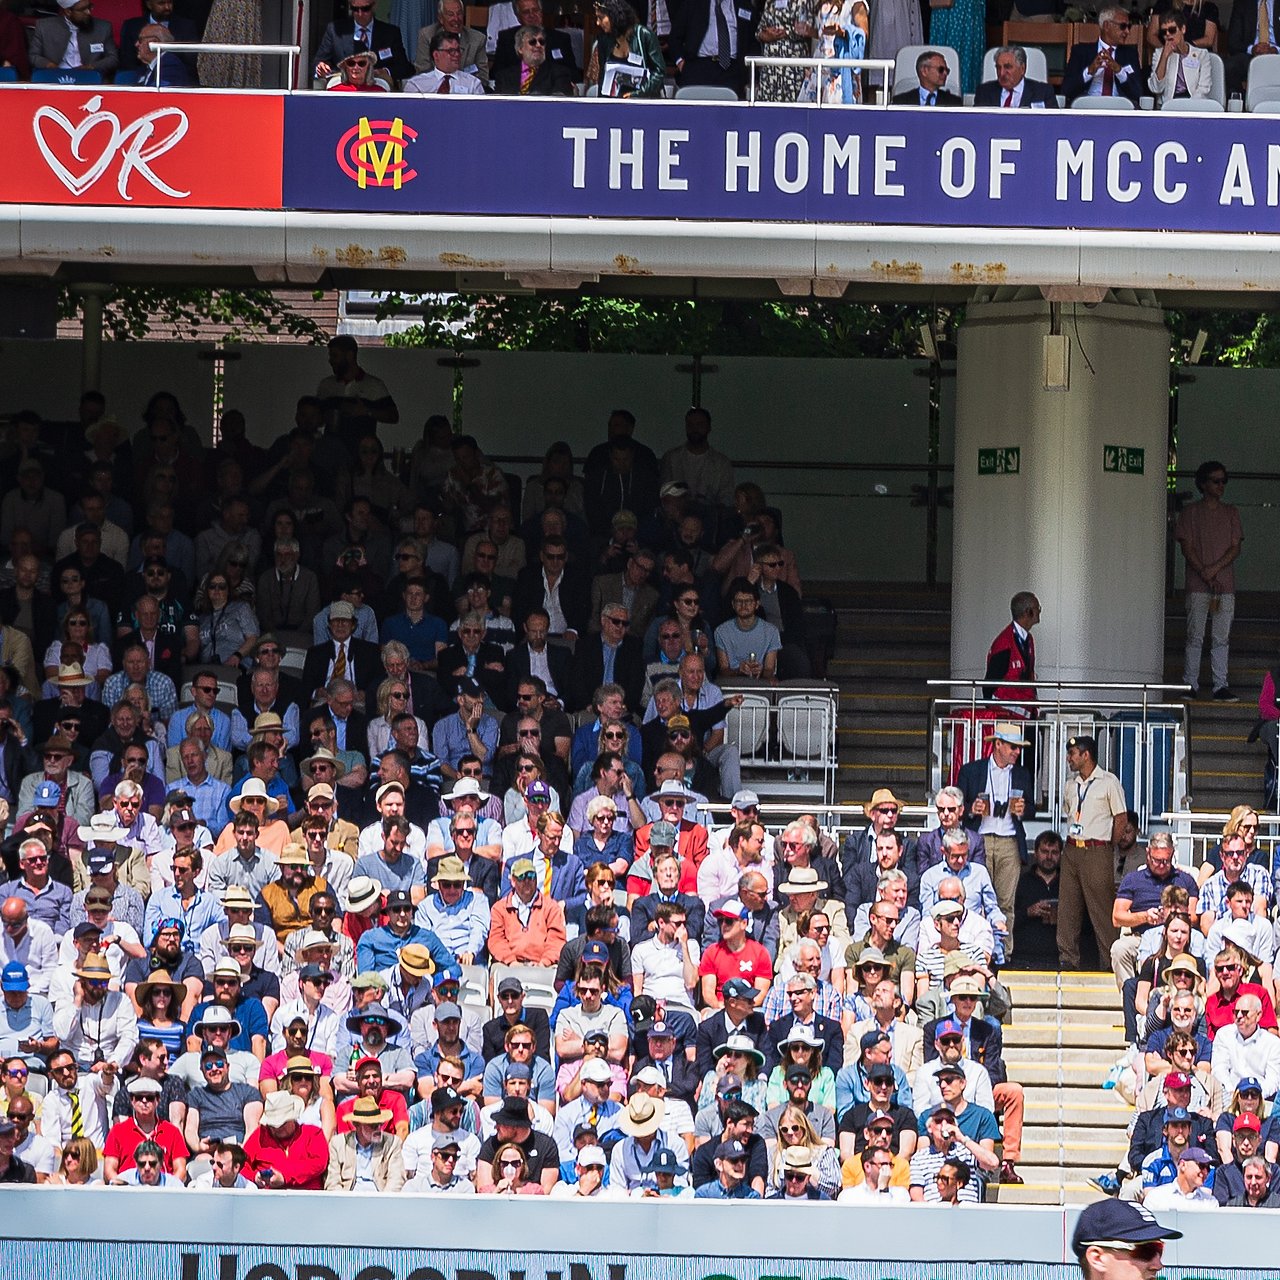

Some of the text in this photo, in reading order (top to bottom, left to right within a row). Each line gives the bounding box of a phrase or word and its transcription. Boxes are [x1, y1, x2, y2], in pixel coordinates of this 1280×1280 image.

[562, 127, 690, 191] THE
[725, 131, 907, 197] HOME
[940, 136, 1022, 199] OF
[1055, 139, 1189, 203] MCC
[980, 455, 994, 468] Exit
[1128, 454, 1142, 468] Exit
